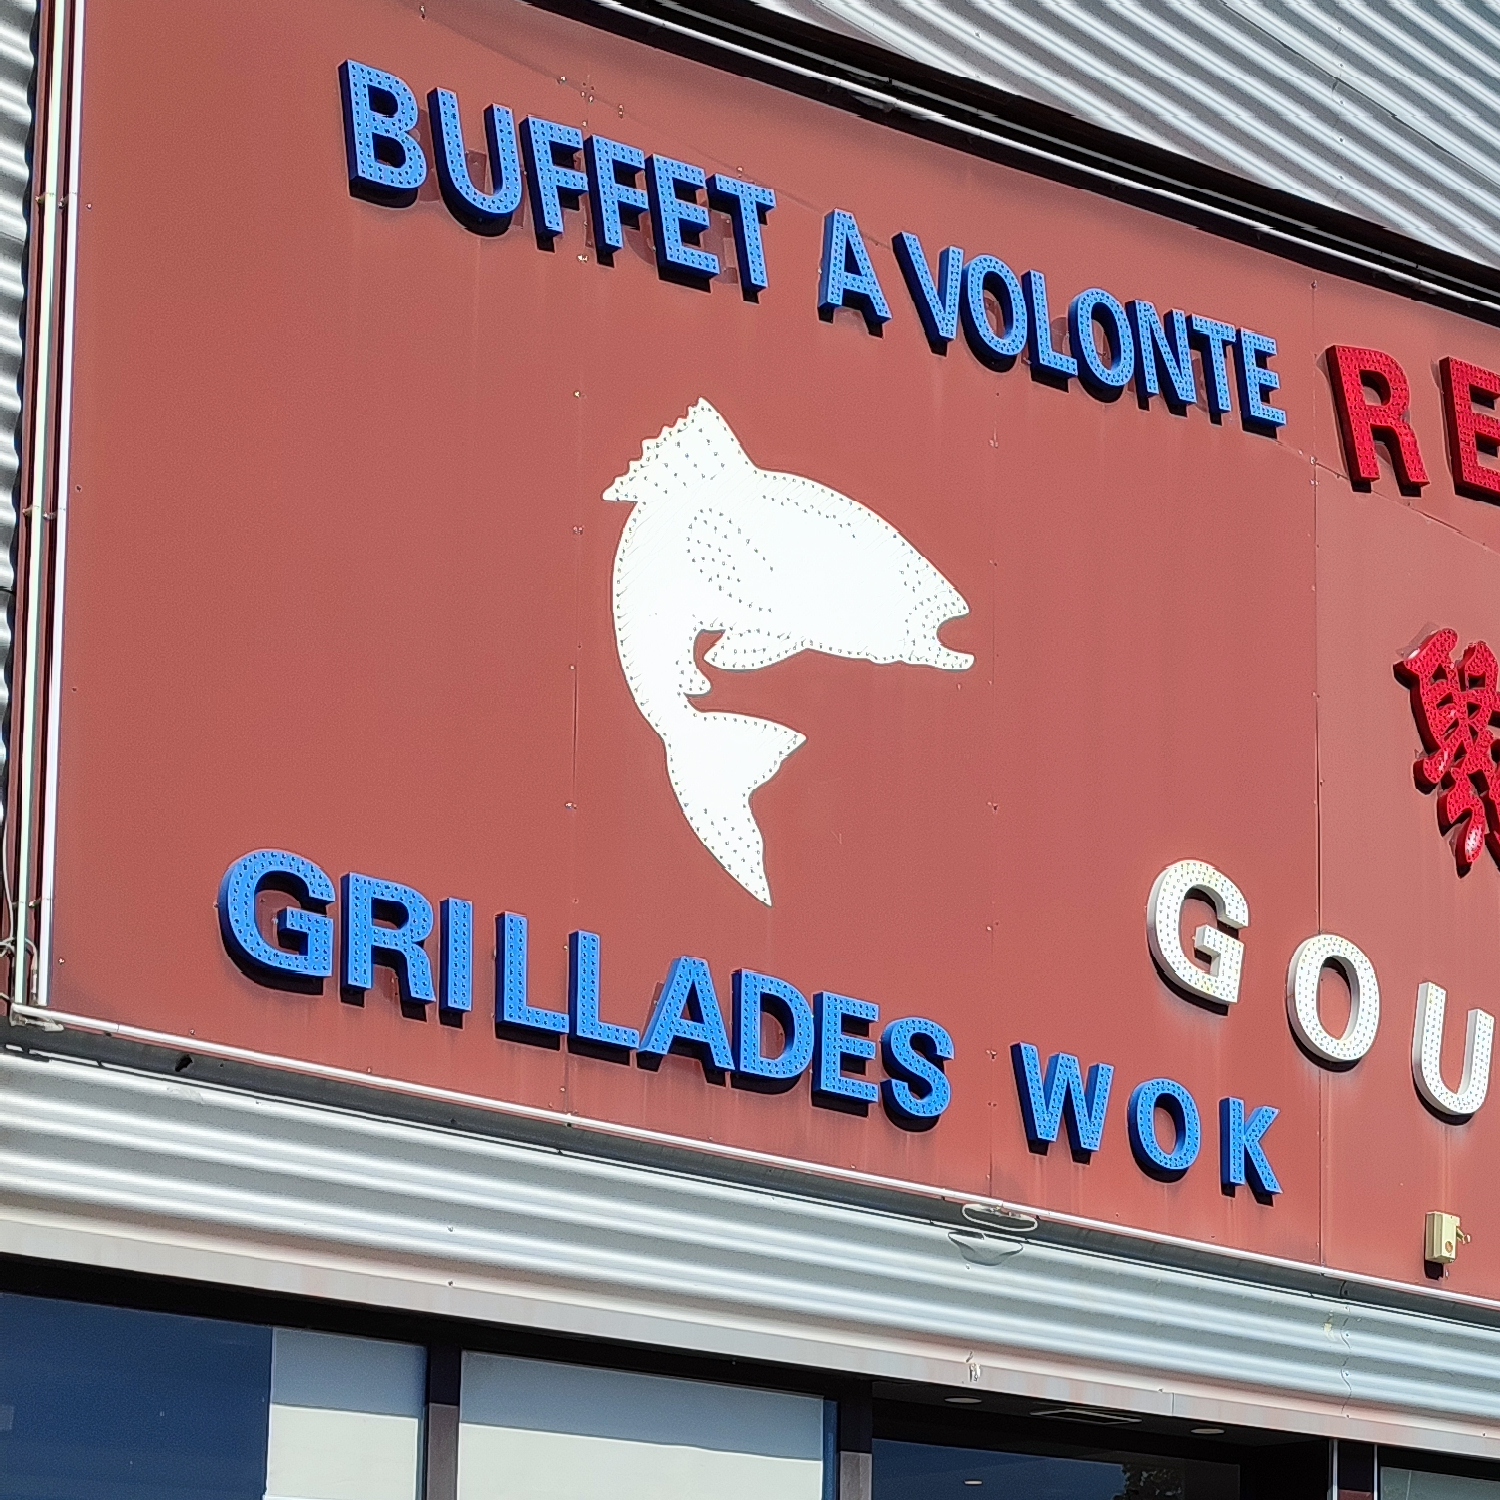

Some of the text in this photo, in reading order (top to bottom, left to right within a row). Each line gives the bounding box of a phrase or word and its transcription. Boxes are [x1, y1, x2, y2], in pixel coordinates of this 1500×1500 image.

[339, 59, 1287, 430] BUFFET A VOLONTE
[217, 849, 1282, 1197] GRILLADES WOK
